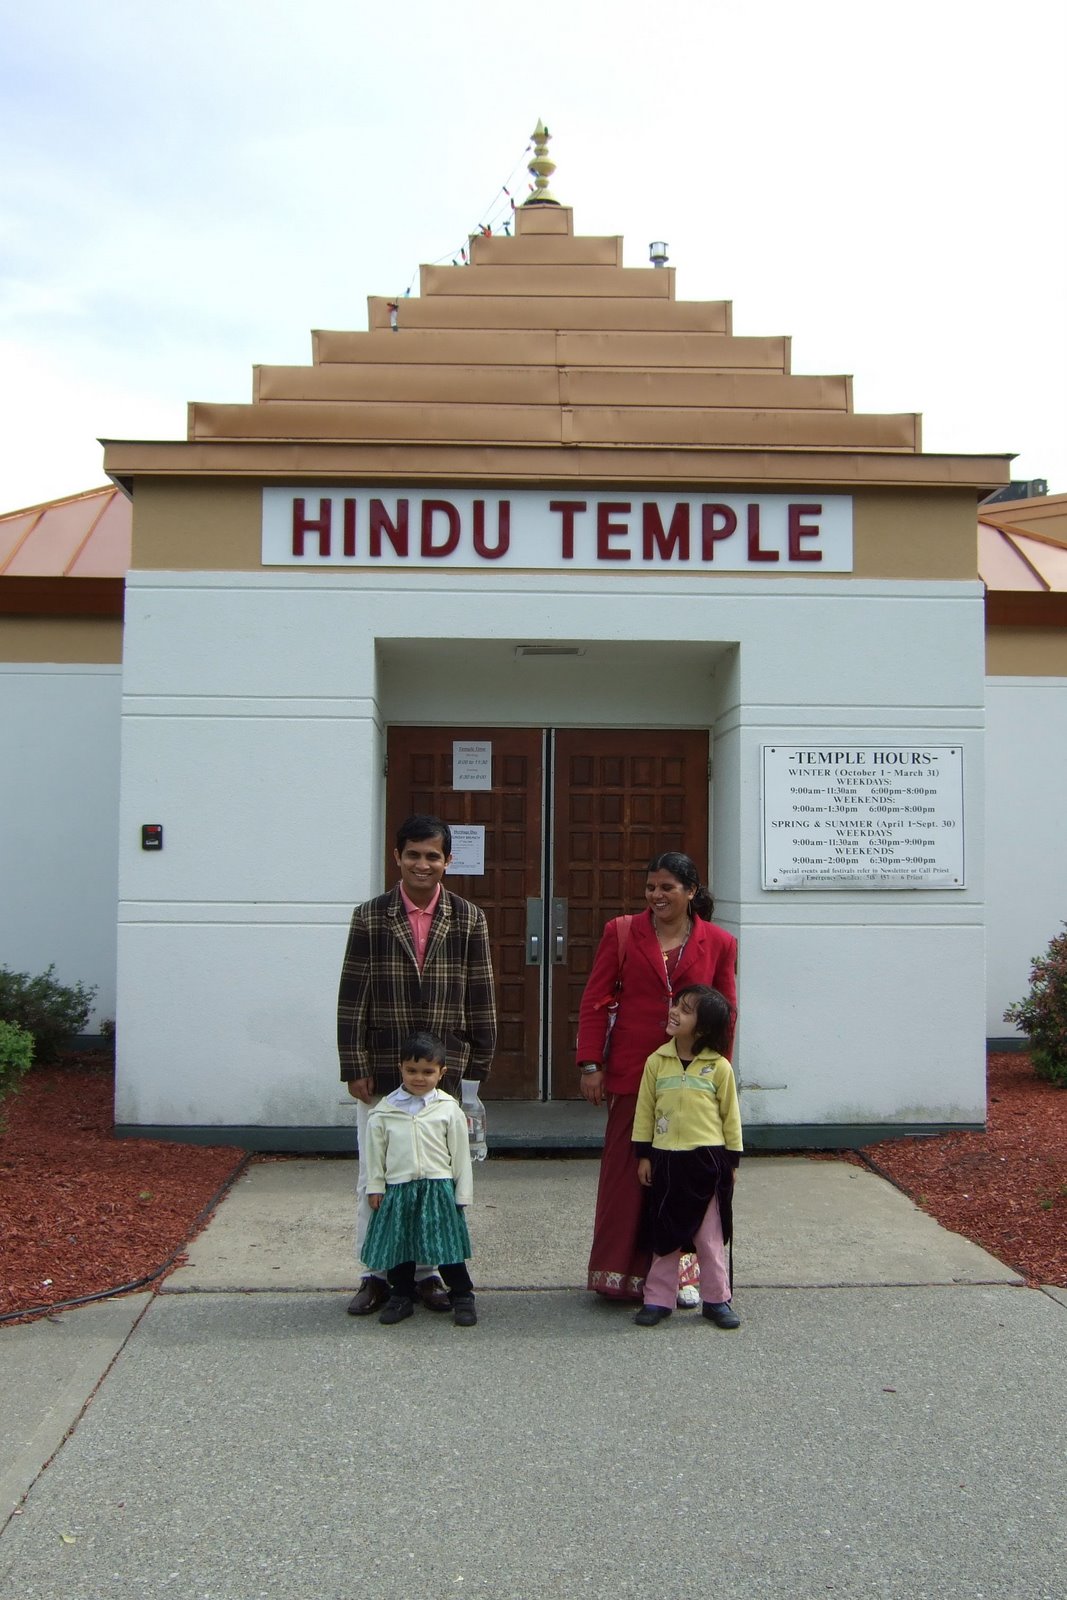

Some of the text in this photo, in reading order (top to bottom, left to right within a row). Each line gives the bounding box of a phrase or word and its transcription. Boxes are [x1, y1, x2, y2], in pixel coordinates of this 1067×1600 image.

[292, 498, 823, 562] HINDU TEMPLE
[788, 769, 831, 777] WINTER
[835, 768, 876, 777] (October
[894, 769, 923, 777] March
[927, 769, 940, 777] 31)
[836, 778, 892, 786] WEEKDAYS:
[790, 787, 937, 796] 9:00am-11:30am 6:00pm-8:00pm
[833, 796, 896, 804] WEEKENDS:
[792, 805, 935, 814] 9:00am-1:30pm 6:00pm-8:00pm
[771, 820, 810, 828] SPRING
[814, 820, 821, 828] &
[825, 820, 873, 828] SUMMER
[876, 820, 904, 829] (April
[942, 820, 955, 828] 30)
[836, 829, 893, 837] WEEKDAYS
[792, 838, 935, 847] 9:00am-11:30am 6:30pm-9:00pm
[835, 847, 894, 855] WEEKENDS
[792, 857, 936, 865] 9:00am-2:00pm 6:30pm-9:00pm
